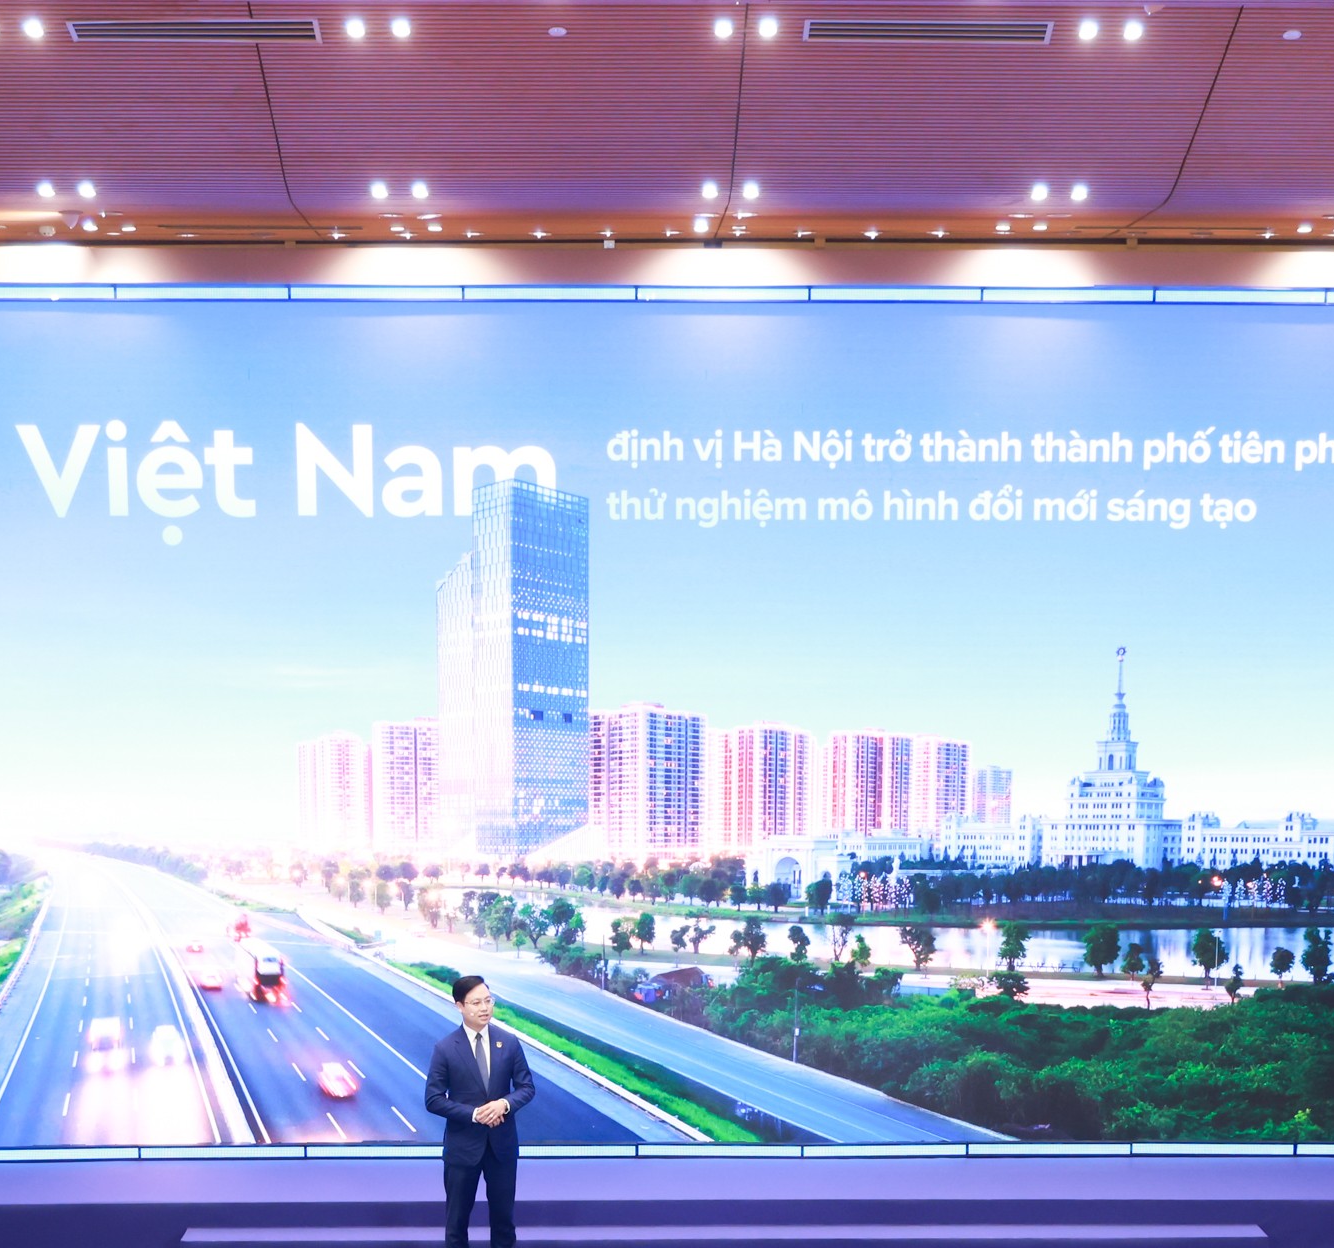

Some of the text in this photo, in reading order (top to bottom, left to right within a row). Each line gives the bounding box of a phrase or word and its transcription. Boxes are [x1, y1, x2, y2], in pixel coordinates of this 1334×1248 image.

[606, 429, 683, 469] định
[693, 429, 722, 470] vị
[733, 429, 781, 462] Hà
[793, 429, 852, 470] Nội
[862, 428, 913, 462] trở
[920, 429, 1022, 463] thành
[1031, 430, 1133, 463] thành
[1143, 426, 1216, 470] phố
[1219, 430, 1285, 464] tiên
[14, 418, 557, 546] Việt Nam
[606, 484, 1258, 530] thử nghiệm mô hình đổi mới sáng tạo
